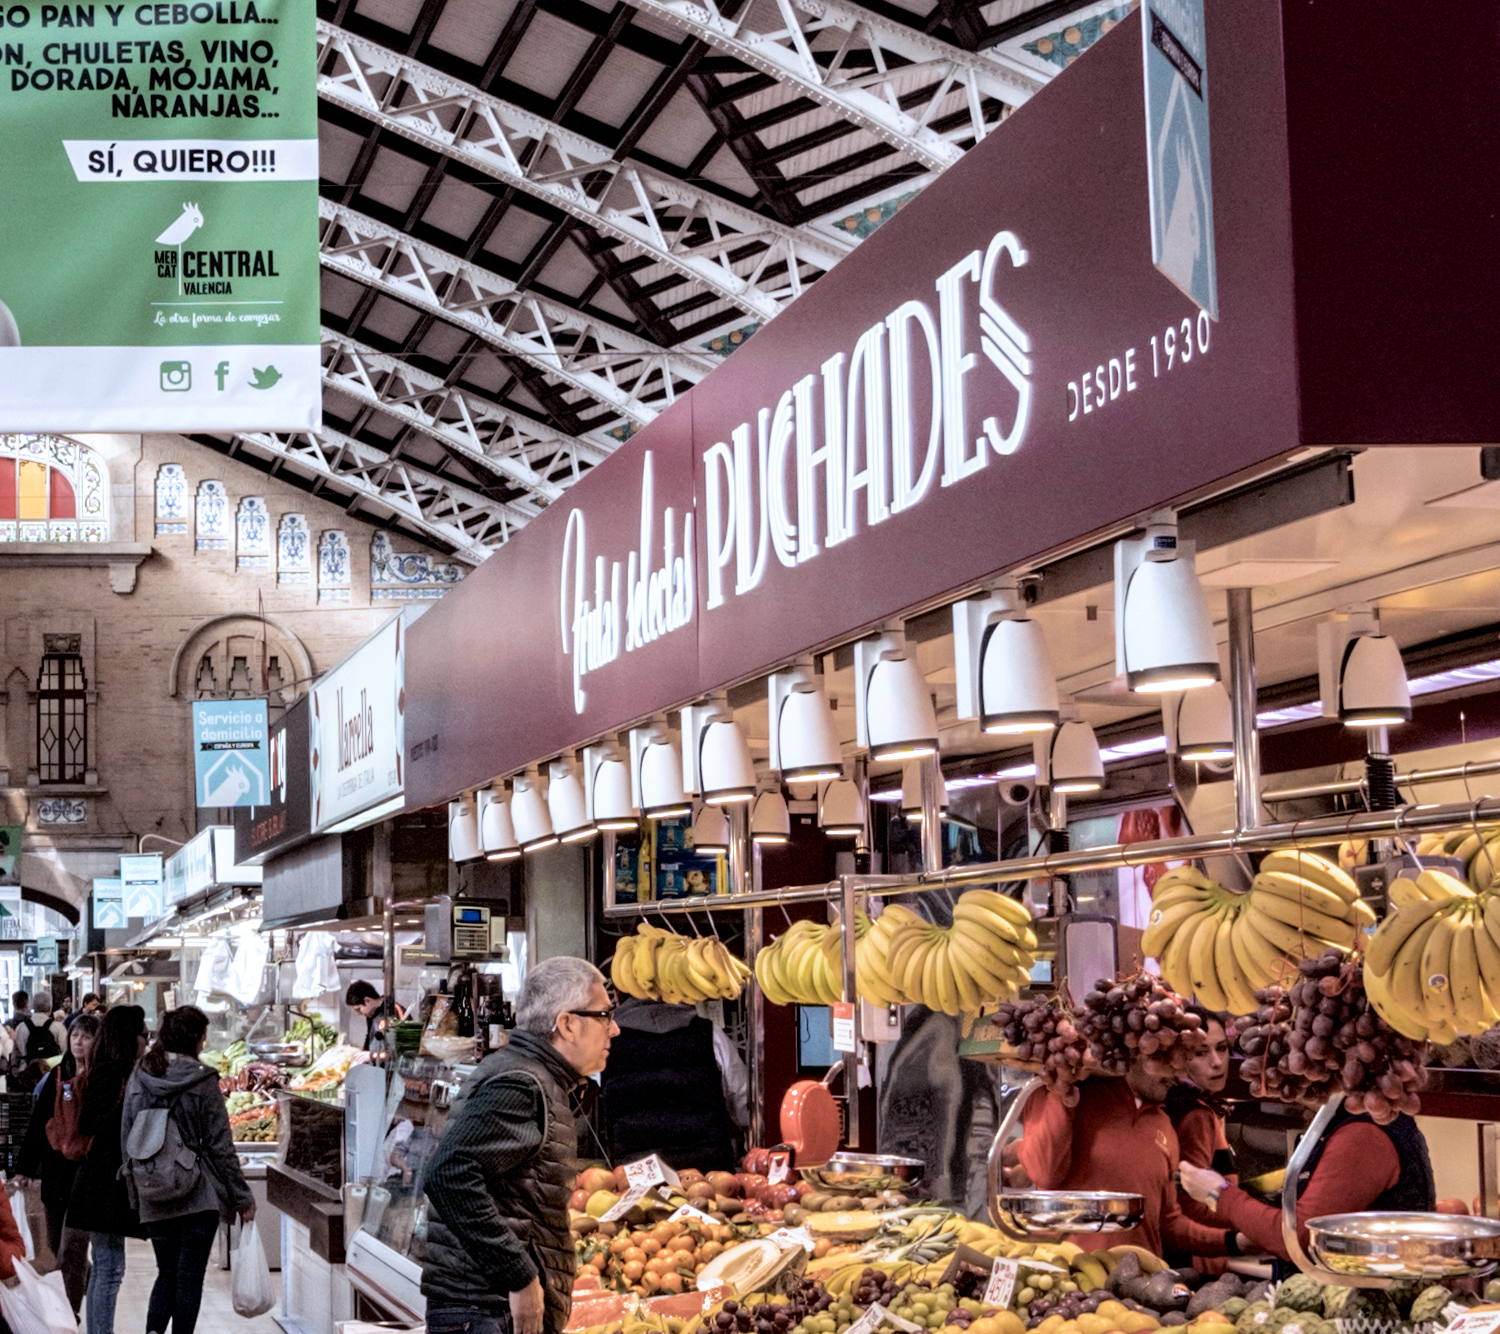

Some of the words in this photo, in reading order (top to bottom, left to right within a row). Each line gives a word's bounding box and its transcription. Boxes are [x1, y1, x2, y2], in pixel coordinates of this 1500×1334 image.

[41, 4, 96, 28] PAN
[106, 4, 122, 27] Y
[134, 1, 279, 27] CEBOLLA...
[42, 41, 192, 69] CHULETAS,
[202, 40, 279, 68] VINO,
[11, 67, 139, 96] DORADA,
[111, 94, 279, 119] NARANJAS...
[88, 144, 122, 176] SÍ,
[133, 149, 276, 174] QUIERO!!!
[155, 251, 177, 264] MER
[157, 265, 176, 278] CAT
[183, 250, 279, 278] CENTRAL
[153, 311, 167, 326] La
[169, 312, 190, 324] otra
[192, 312, 222, 328] forma
[225, 311, 236, 323] de
[1067, 347, 1138, 422] DESDE
[1149, 308, 1211, 378] 1930
[560, 508, 620, 714] Frutas
[703, 230, 1033, 610] PUCHADES
[199, 710, 251, 725] Servicio
[253, 714, 263, 724] a
[200, 726, 263, 741] domicilio
